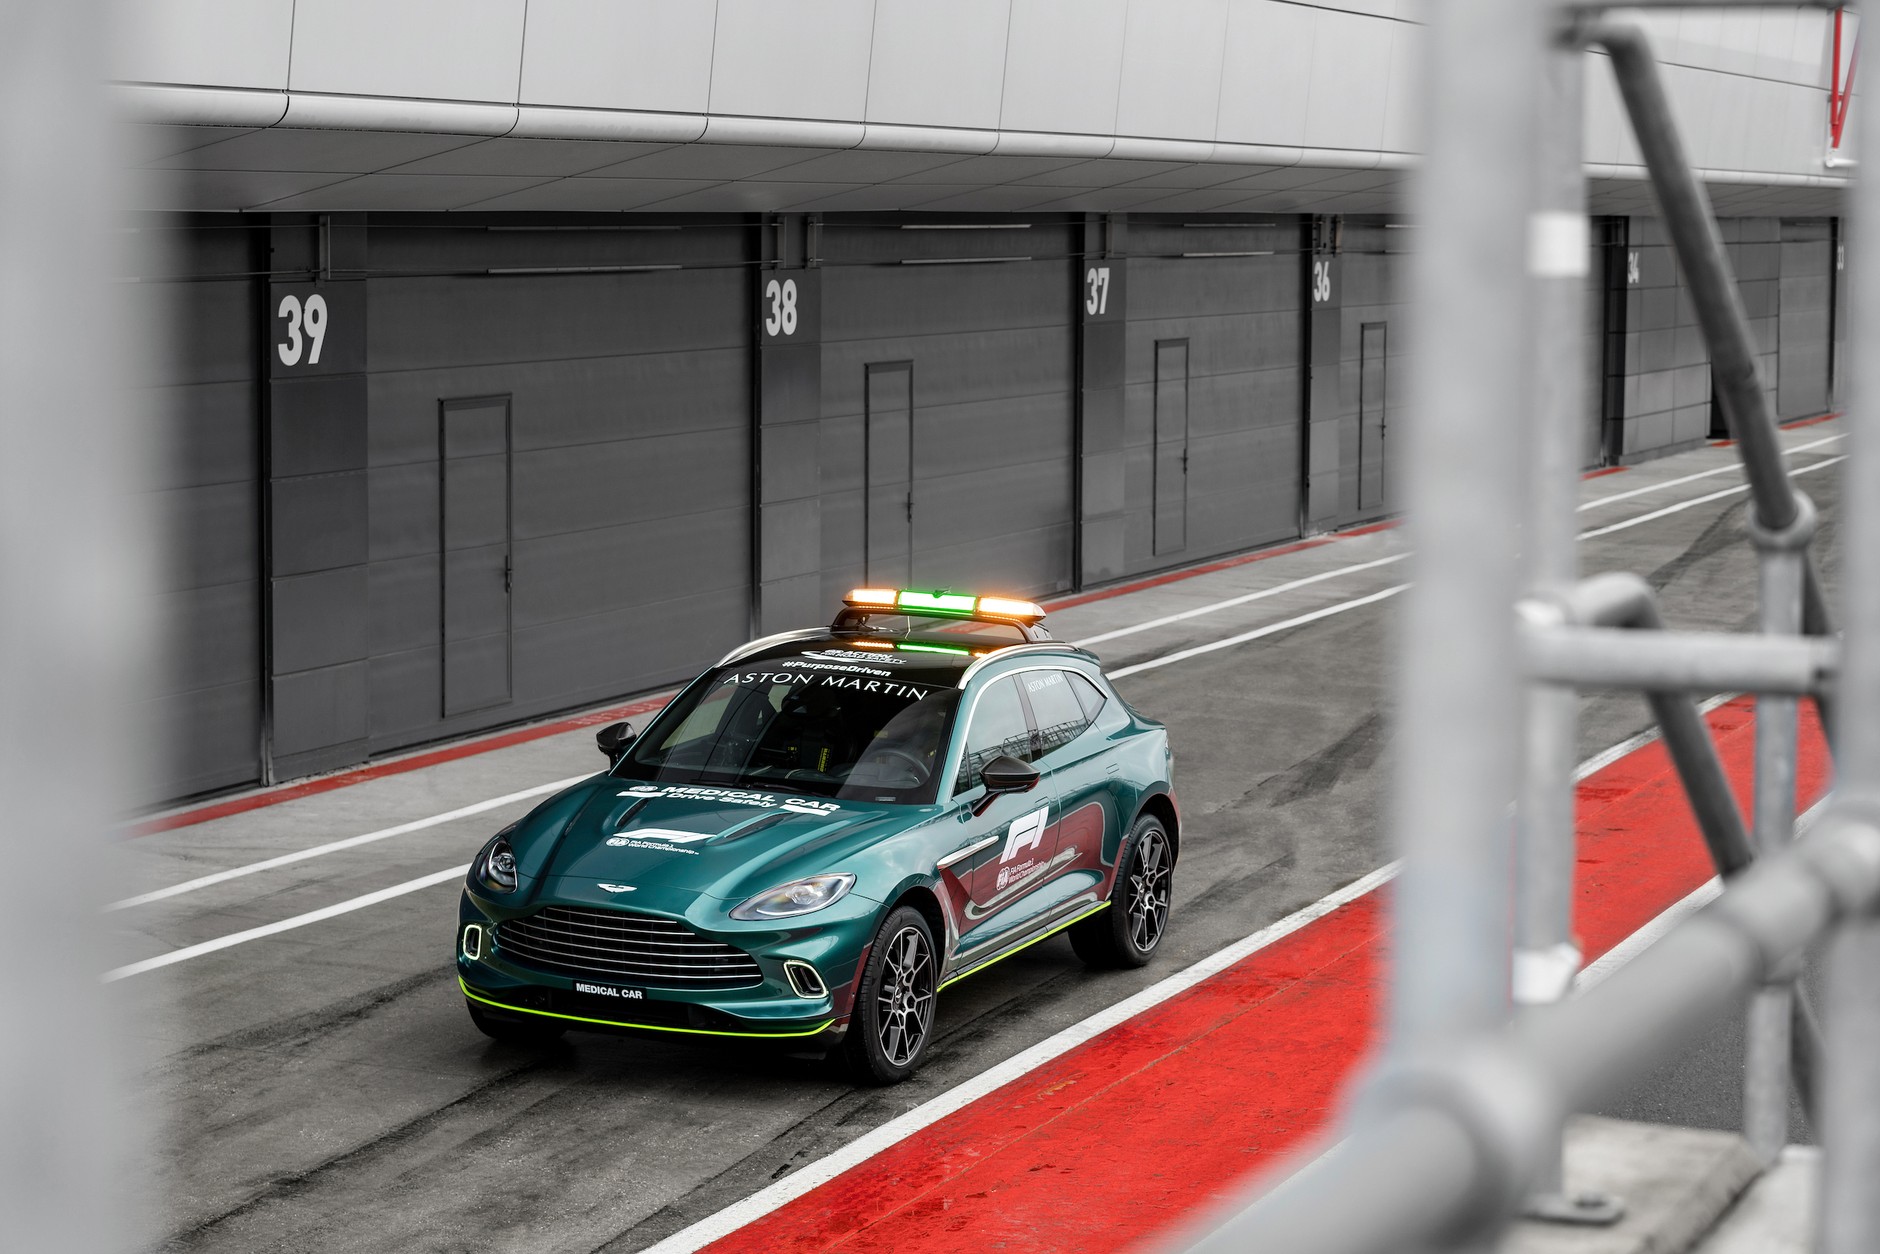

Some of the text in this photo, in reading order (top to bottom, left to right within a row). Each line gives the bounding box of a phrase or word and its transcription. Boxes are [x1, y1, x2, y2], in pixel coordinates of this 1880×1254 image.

[1628, 252, 1639, 283] 34
[1087, 267, 1110, 315] 37
[1314, 261, 1330, 302] 36
[766, 279, 797, 336] 38
[278, 293, 328, 366] 39
[782, 661, 892, 677] #PurposeDriven
[1028, 673, 1063, 692] ASTON MARTIN
[724, 673, 928, 700] ASTON MARTIN
[661, 786, 776, 802] MEDICAL
[785, 798, 841, 812] CAR
[666, 792, 777, 808] Drive Safely
[576, 983, 643, 999] MEDICAL CAR
